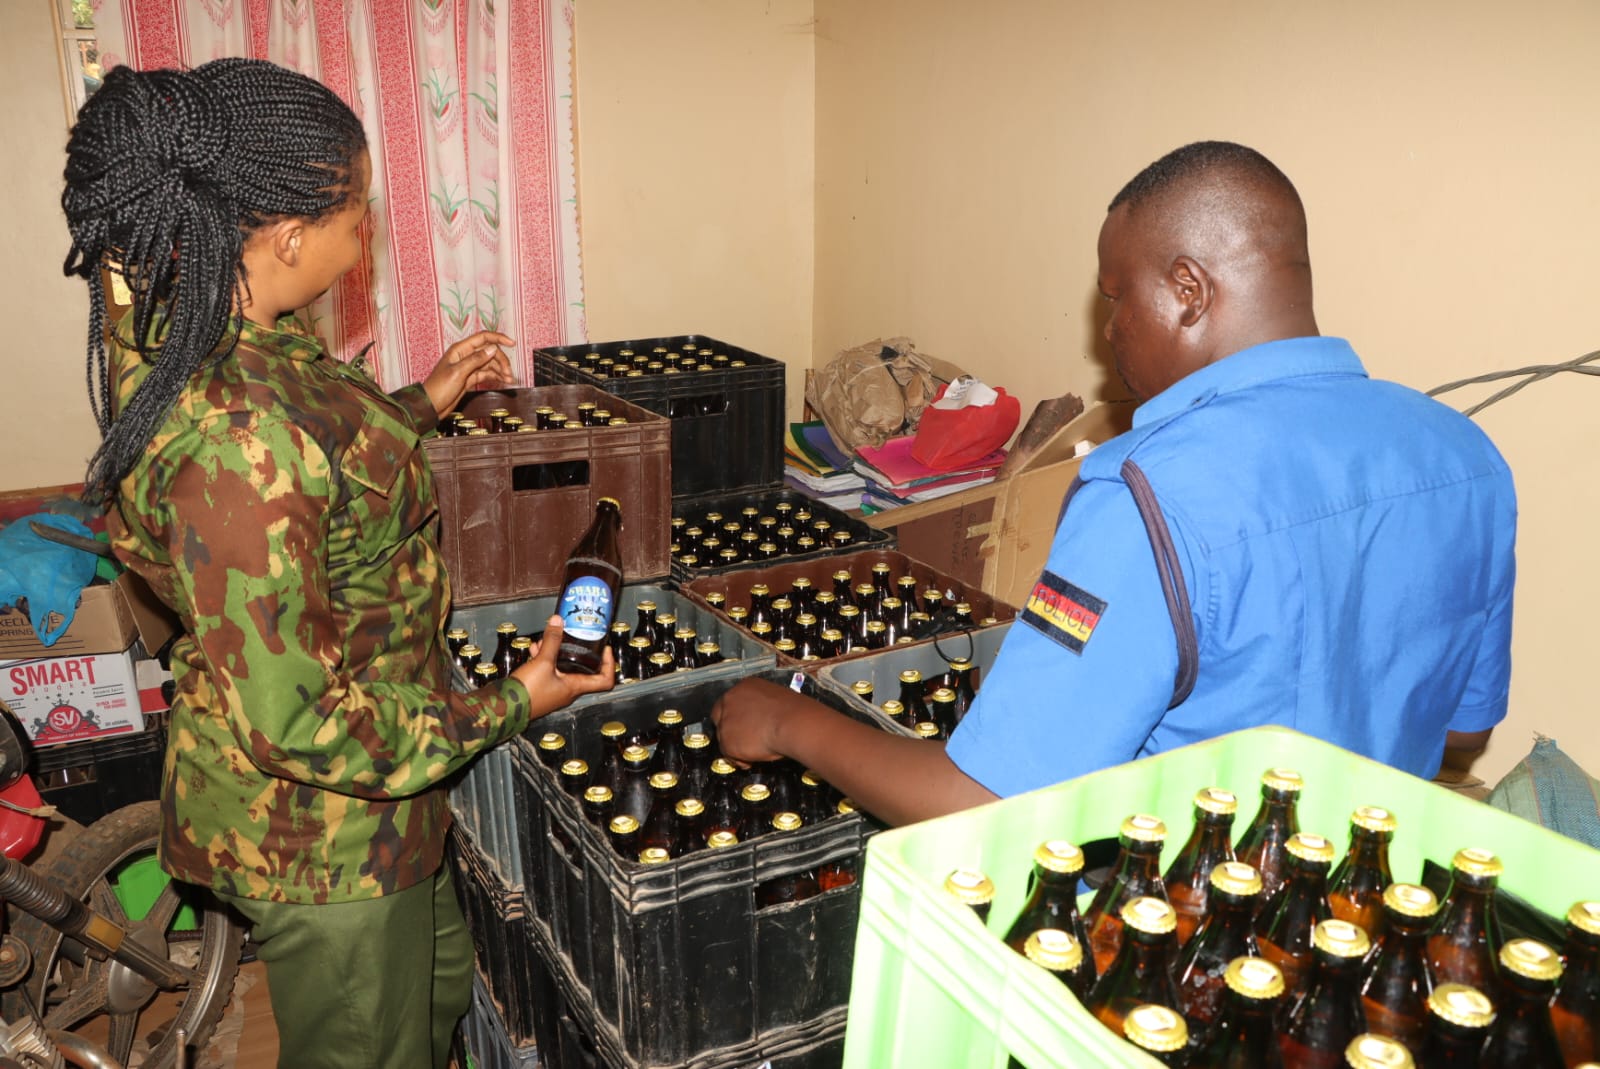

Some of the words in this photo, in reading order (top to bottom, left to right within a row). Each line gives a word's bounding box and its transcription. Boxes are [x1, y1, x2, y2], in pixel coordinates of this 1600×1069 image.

[1033, 589, 1093, 634] POLICE
[10, 657, 96, 695] SMART
[53, 710, 75, 727] SV
